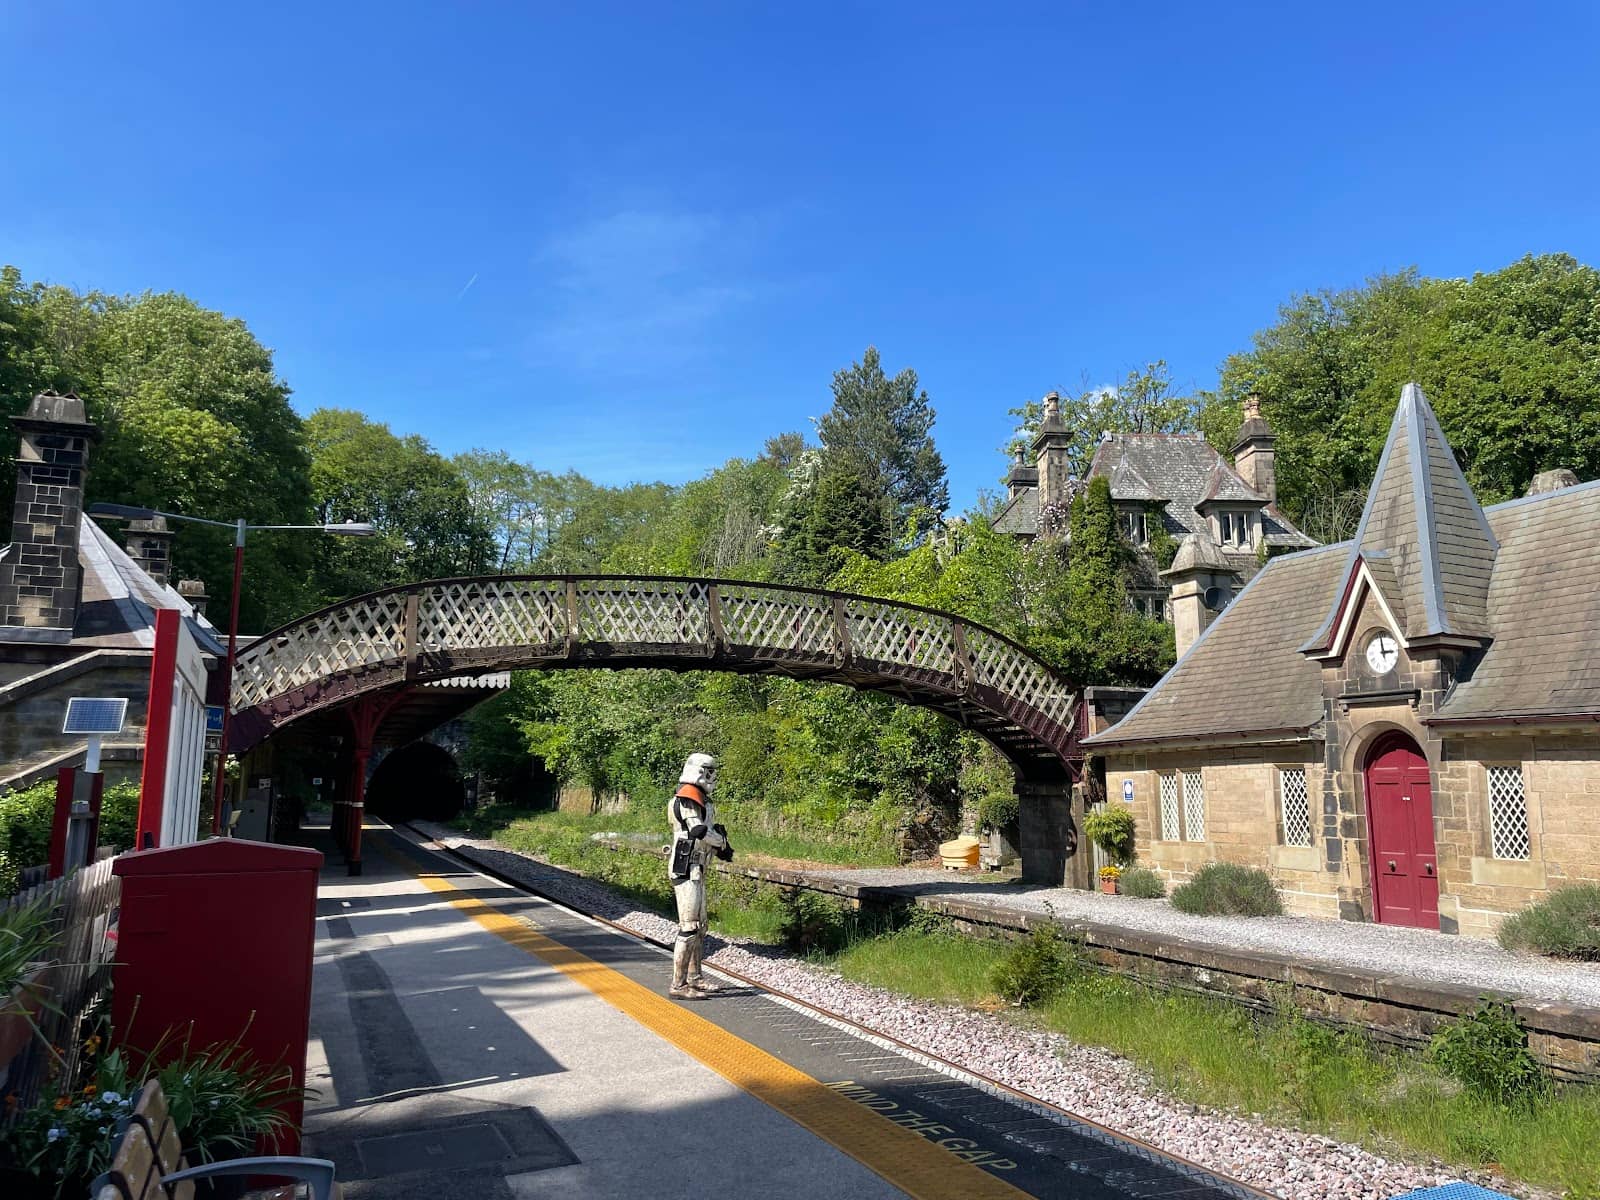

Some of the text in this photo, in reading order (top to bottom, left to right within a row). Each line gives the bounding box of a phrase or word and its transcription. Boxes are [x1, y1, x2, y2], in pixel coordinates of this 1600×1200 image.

[823, 1080, 1018, 1169] MIND THE GAP
